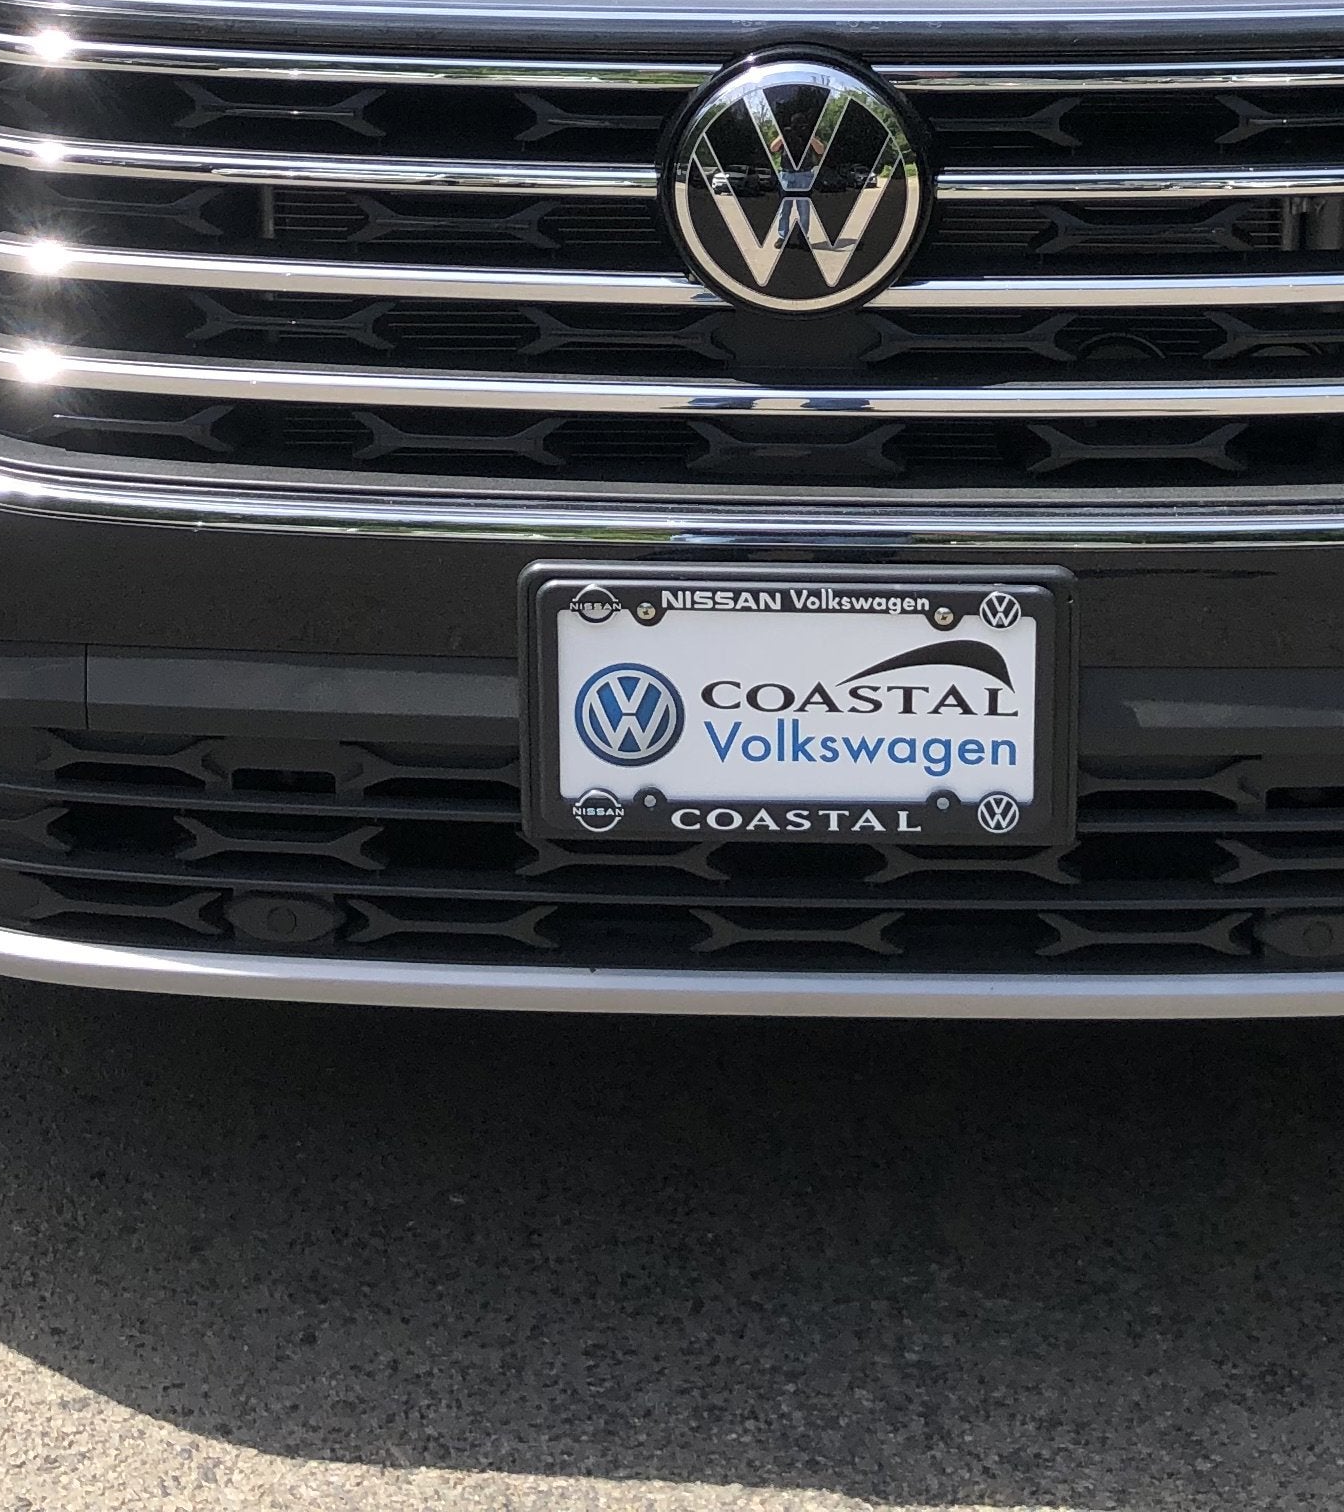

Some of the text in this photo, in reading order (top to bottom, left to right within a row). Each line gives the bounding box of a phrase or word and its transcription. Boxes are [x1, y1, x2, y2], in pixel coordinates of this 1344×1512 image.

[569, 602, 622, 611] NISSAN
[661, 588, 930, 614] NISSAN Volkswagen
[701, 680, 1019, 717] COASTAL
[703, 718, 1017, 777] Volkswagen
[572, 806, 625, 816] NISSAN
[671, 807, 922, 832] COASTAL
